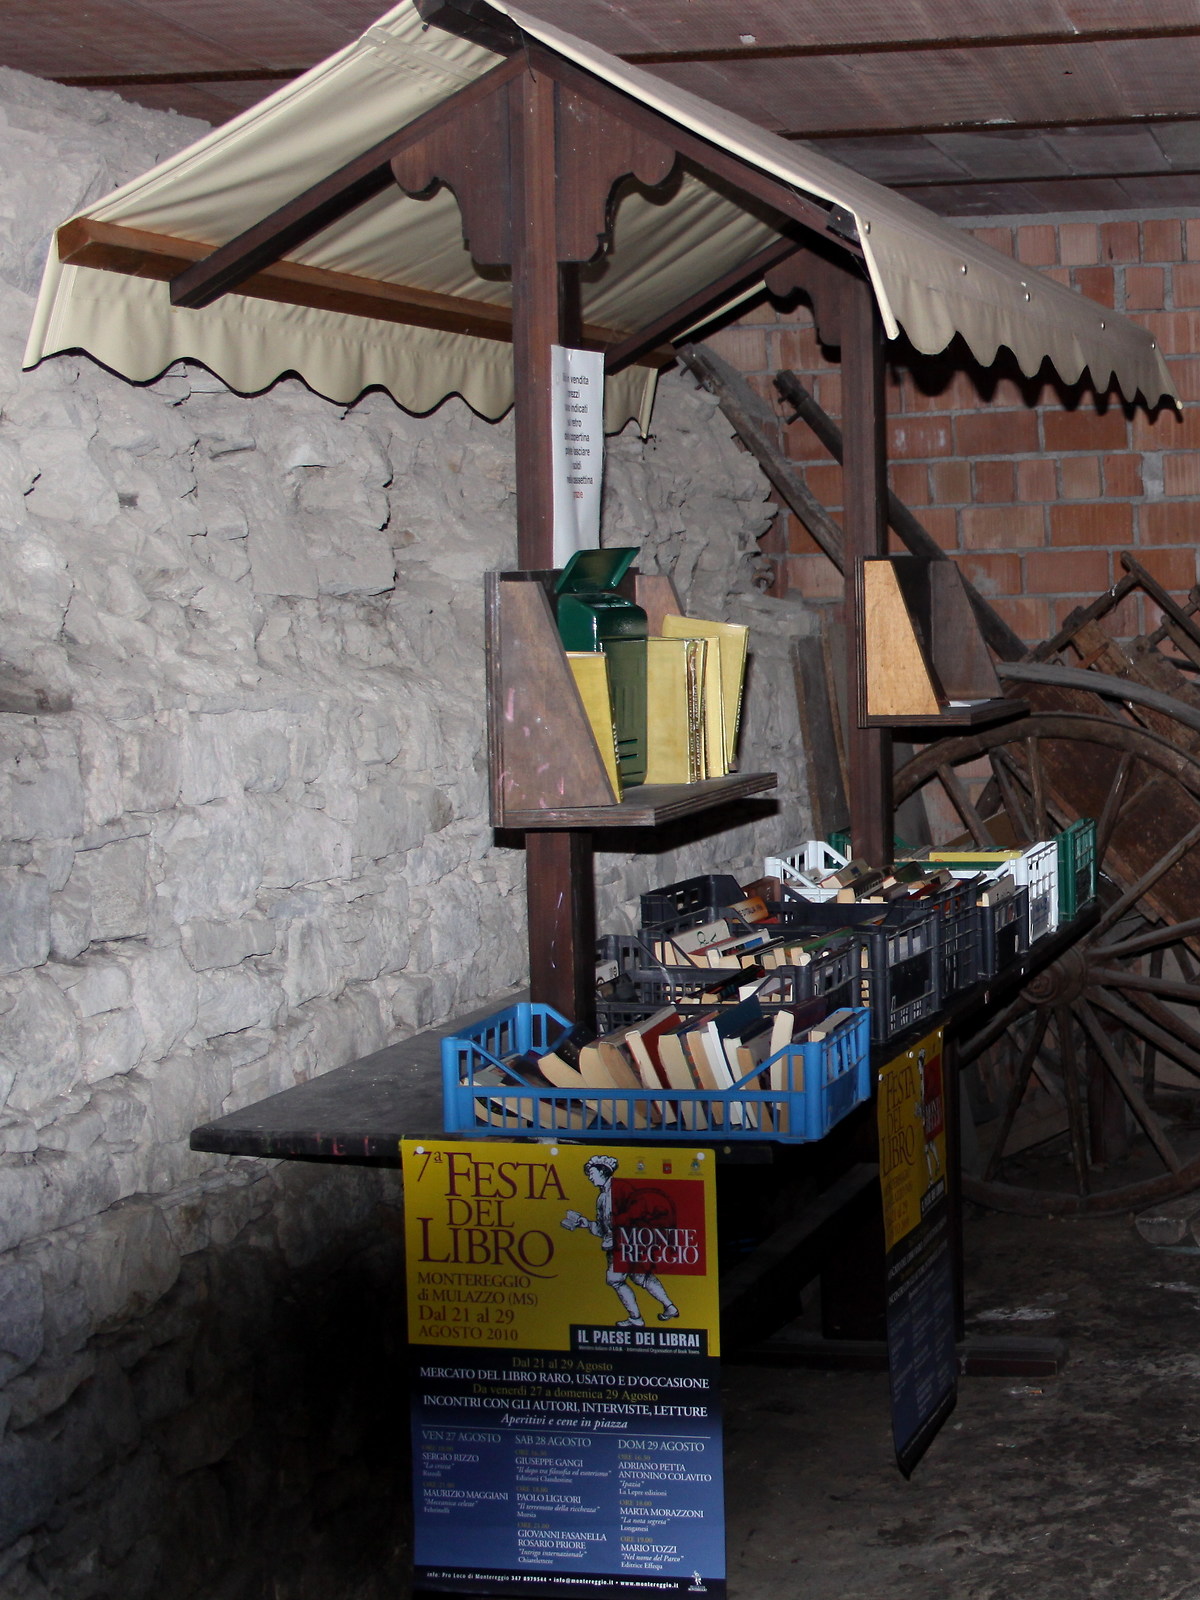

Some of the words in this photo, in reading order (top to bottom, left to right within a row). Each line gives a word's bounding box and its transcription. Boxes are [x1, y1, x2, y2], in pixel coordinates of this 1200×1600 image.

[887, 1066, 916, 1114] FESTA
[887, 1107, 904, 1138] DEL
[882, 1125, 916, 1177] LIBRO
[443, 1151, 570, 1200] FESTA
[446, 1198, 515, 1228] DEL
[416, 1217, 559, 1278] LIBRO
[619, 1227, 698, 1247] MONTE
[619, 1243, 699, 1264] REGGIO
[417, 1271, 531, 1288] MONTEREGGIO
[416, 1287, 429, 1301] di
[431, 1288, 505, 1304] MULAZZO
[508, 1292, 537, 1305] (MS)
[418, 1305, 446, 1321] Dal
[451, 1306, 469, 1322] 21
[476, 1307, 489, 1323] al
[495, 1308, 514, 1324] 29
[418, 1324, 482, 1339] AGOSTO
[487, 1327, 518, 1341] 2010
[578, 1329, 588, 1343] IL
[593, 1330, 631, 1344] PAESE
[635, 1332, 654, 1345] DEI
[659, 1332, 699, 1347] LIBRAI
[512, 1357, 530, 1367] Dal
[533, 1358, 544, 1368] 21
[548, 1359, 557, 1368] al
[560, 1359, 573, 1370] 29
[577, 1360, 613, 1374] Agosto
[420, 1366, 475, 1379] MERCATO
[478, 1369, 500, 1380] DEL
[502, 1370, 537, 1382] LIBRO
[539, 1372, 573, 1384] RARO,
[576, 1373, 615, 1385] USATO
[618, 1375, 625, 1385] E
[627, 1375, 709, 1389] D'OCCASIONE
[473, 1383, 486, 1393] Da
[490, 1384, 526, 1395] venerdì
[530, 1385, 541, 1396] 27
[553, 1387, 603, 1399] domenica
[605, 1388, 618, 1400] 29
[621, 1390, 658, 1404] Agosto
[423, 1395, 480, 1407] INCONTRI
[483, 1397, 509, 1408] CON
[511, 1399, 530, 1409] GLI
[532, 1400, 580, 1412] AUTORI,
[582, 1402, 652, 1416] INTERVISTE,
[654, 1404, 707, 1417] LETTURE
[501, 1413, 546, 1428] Aperitivi
[556, 1418, 578, 1427] cene
[580, 1416, 591, 1427] in
[592, 1417, 628, 1432] piazza
